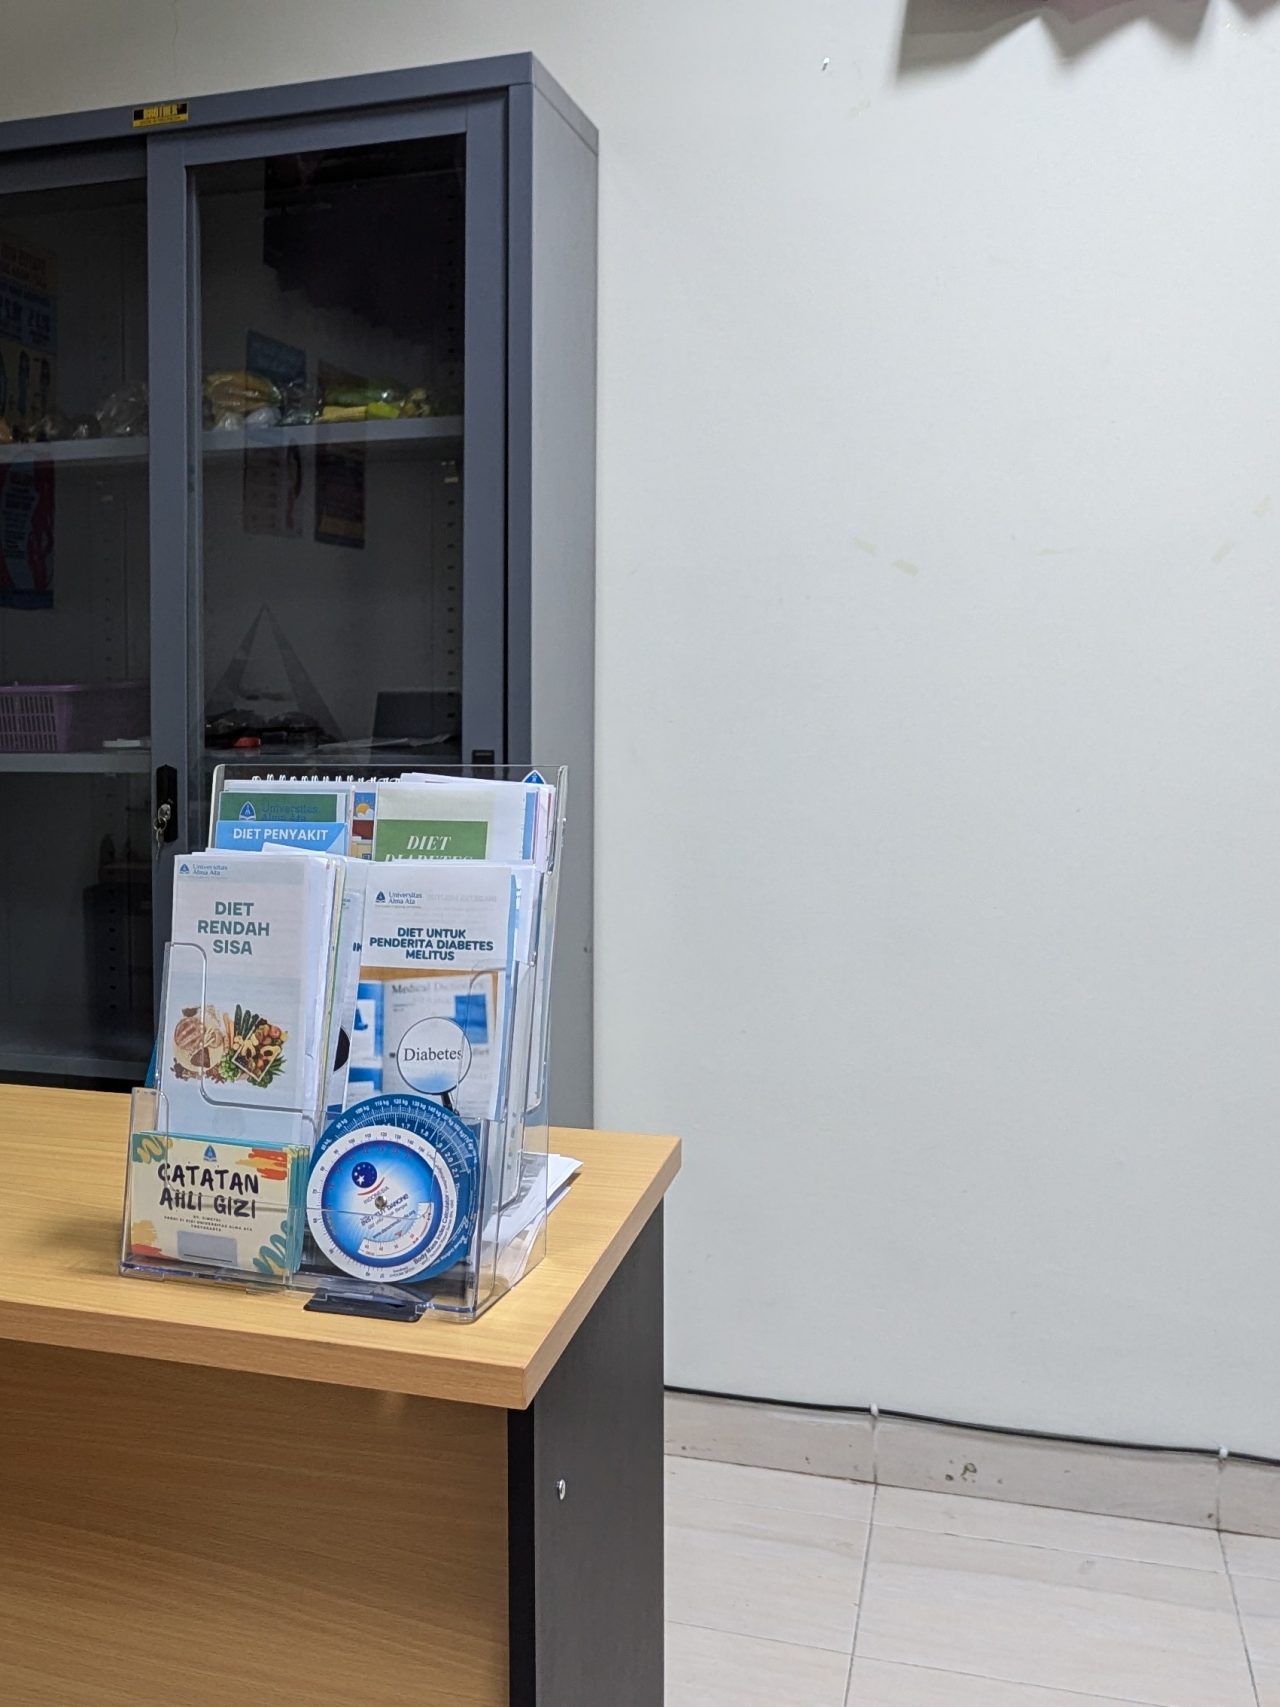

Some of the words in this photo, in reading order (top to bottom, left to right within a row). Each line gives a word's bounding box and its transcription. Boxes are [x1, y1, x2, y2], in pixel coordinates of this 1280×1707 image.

[263, 801, 318, 814] Universitas
[233, 828, 261, 840] DIET
[264, 829, 329, 841] PENYAKIT
[406, 835, 452, 851] DIET
[389, 891, 422, 899] Universitas
[215, 901, 254, 916] DIET
[197, 920, 270, 936] RENDAH
[398, 928, 423, 938] DIET
[427, 928, 466, 939] UNTUK
[212, 939, 253, 955] SISA
[370, 937, 433, 949] PENDERITA
[436, 940, 494, 951] DIABETES
[406, 950, 455, 961] MELITUS
[404, 1047, 464, 1061] Diabetes
[157, 1162, 259, 1195] CATATAN
[159, 1187, 202, 1211] AHLI
[214, 1194, 256, 1219] GIZI
[414, 1254, 428, 1265] Body
[426, 1241, 437, 1255] Mass
[436, 1228, 444, 1242] Index
[441, 1196, 449, 1229] Calculator
